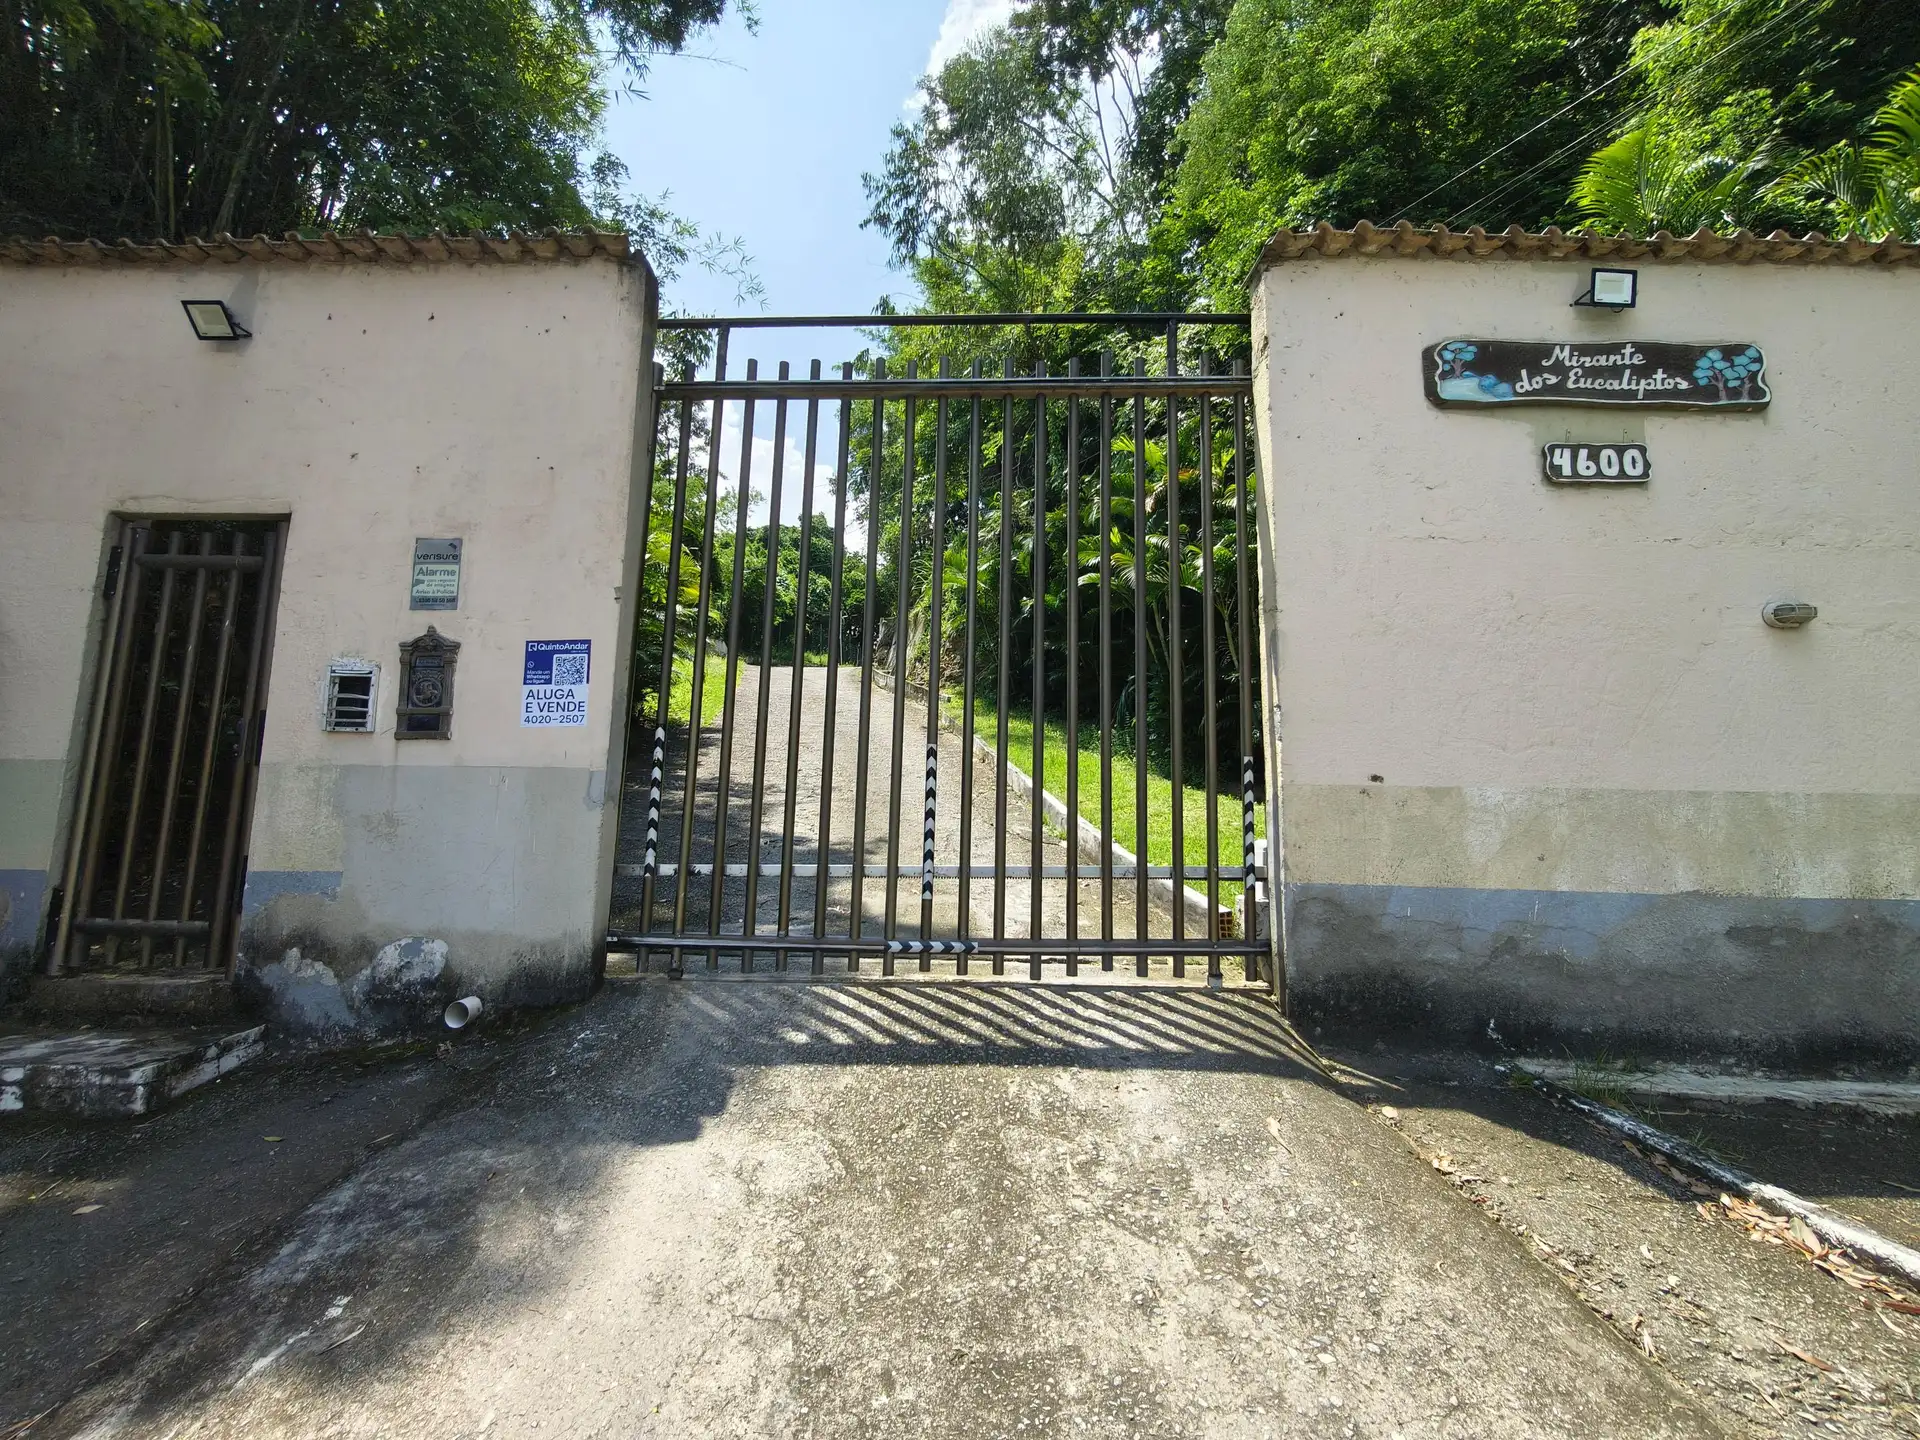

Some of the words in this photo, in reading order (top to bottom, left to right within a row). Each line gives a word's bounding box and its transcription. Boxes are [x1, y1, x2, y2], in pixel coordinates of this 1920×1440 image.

[1541, 343, 1646, 367] Mirante
[1515, 369, 1562, 393] dos
[1566, 368, 1693, 399] Eucaliptos
[1553, 448, 1644, 476] 4600
[416, 566, 457, 576] Alarme
[526, 689, 575, 700] ALUGA
[526, 702, 533, 713] E
[537, 701, 585, 712] VENDE
[524, 715, 585, 724] 4020-2507
